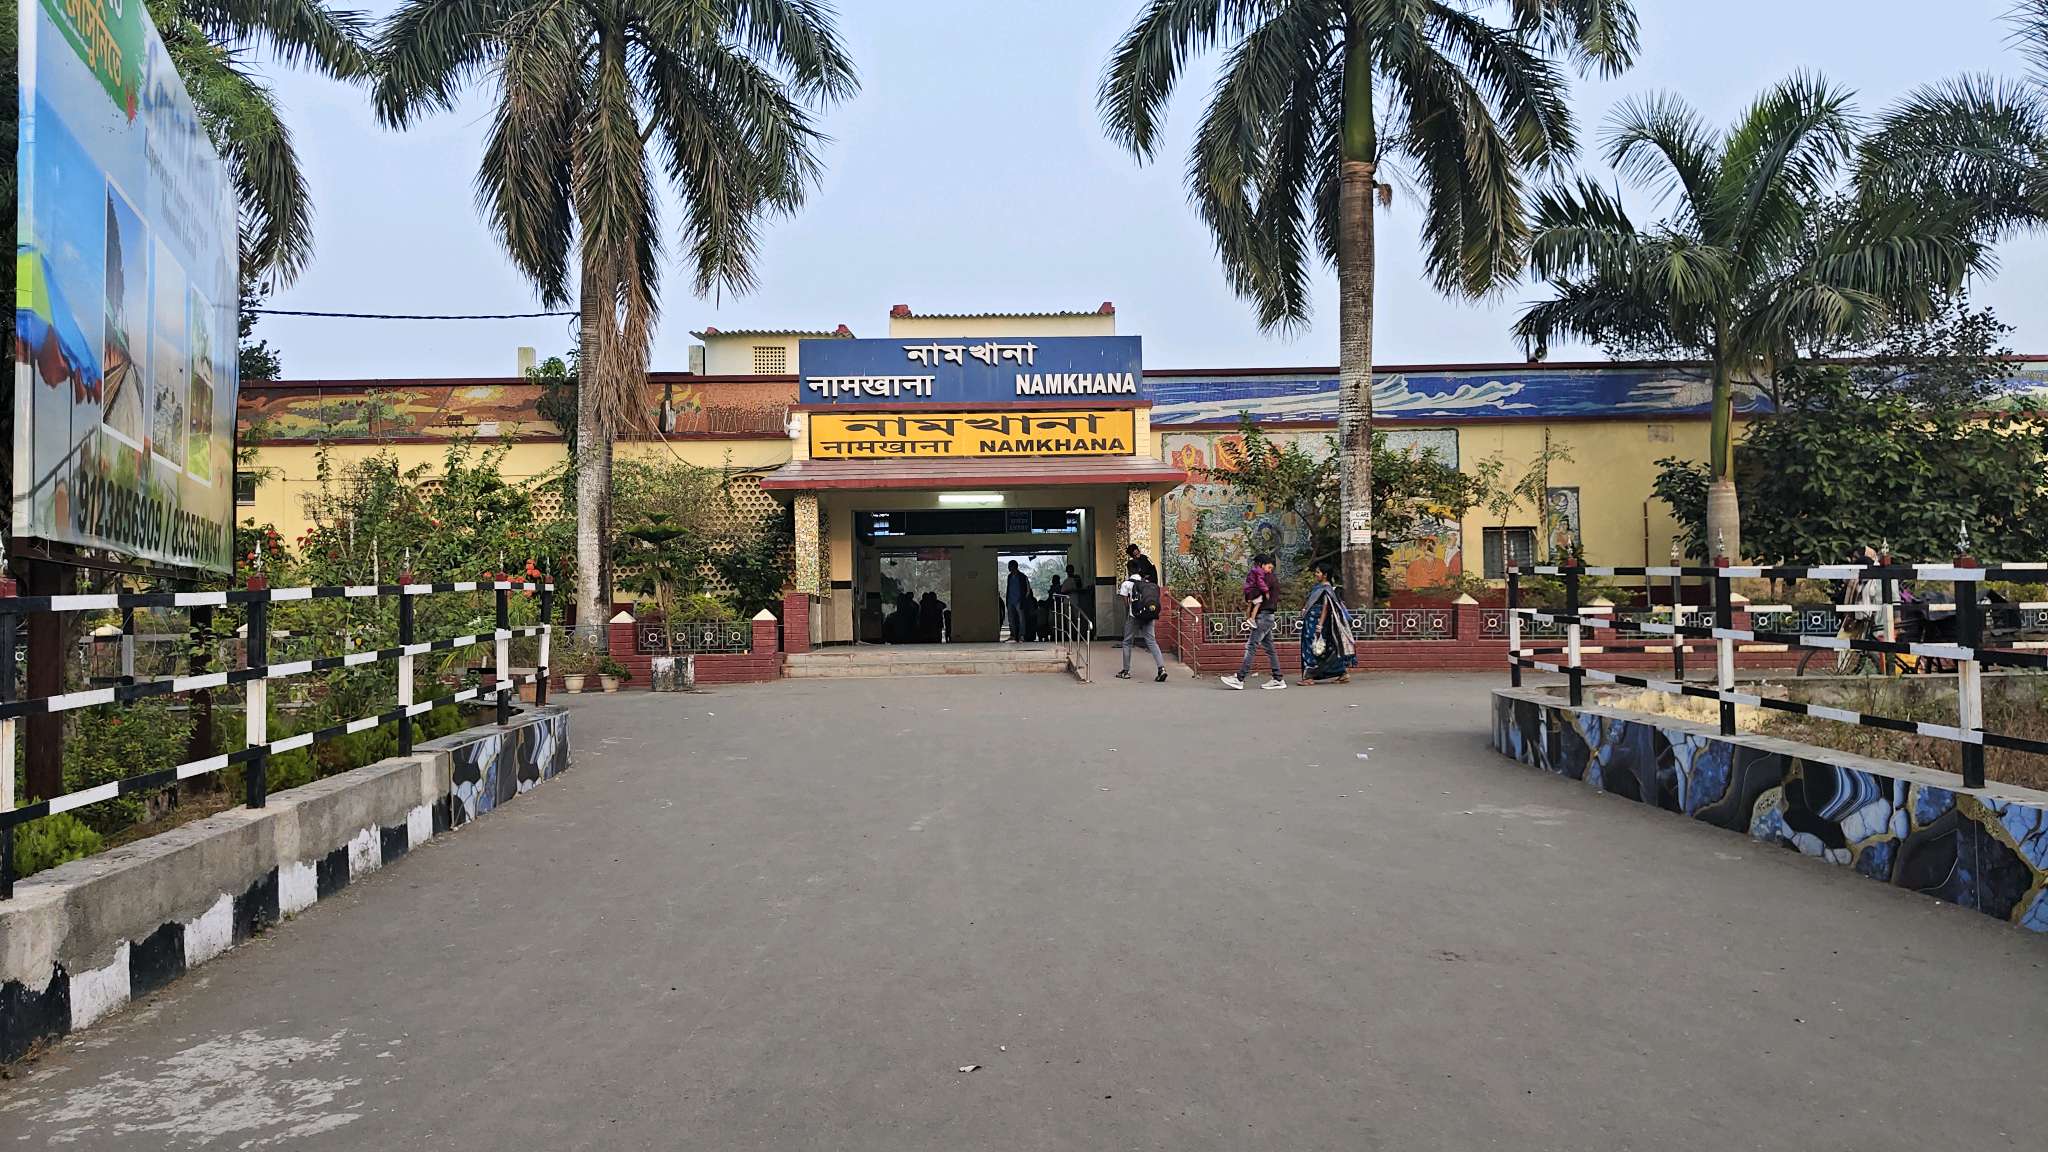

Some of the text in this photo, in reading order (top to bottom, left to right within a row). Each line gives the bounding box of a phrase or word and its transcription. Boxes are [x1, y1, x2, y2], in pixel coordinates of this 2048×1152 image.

[903, 341, 1038, 367] নামখানা
[806, 374, 936, 398] नामखाना
[1015, 373, 1137, 396] NAMKHANA
[841, 414, 1106, 438] নামখানা
[819, 440, 953, 455] नामखाना
[979, 437, 1126, 454] NAMKHANA
[78, 470, 162, 552] 9123856909
